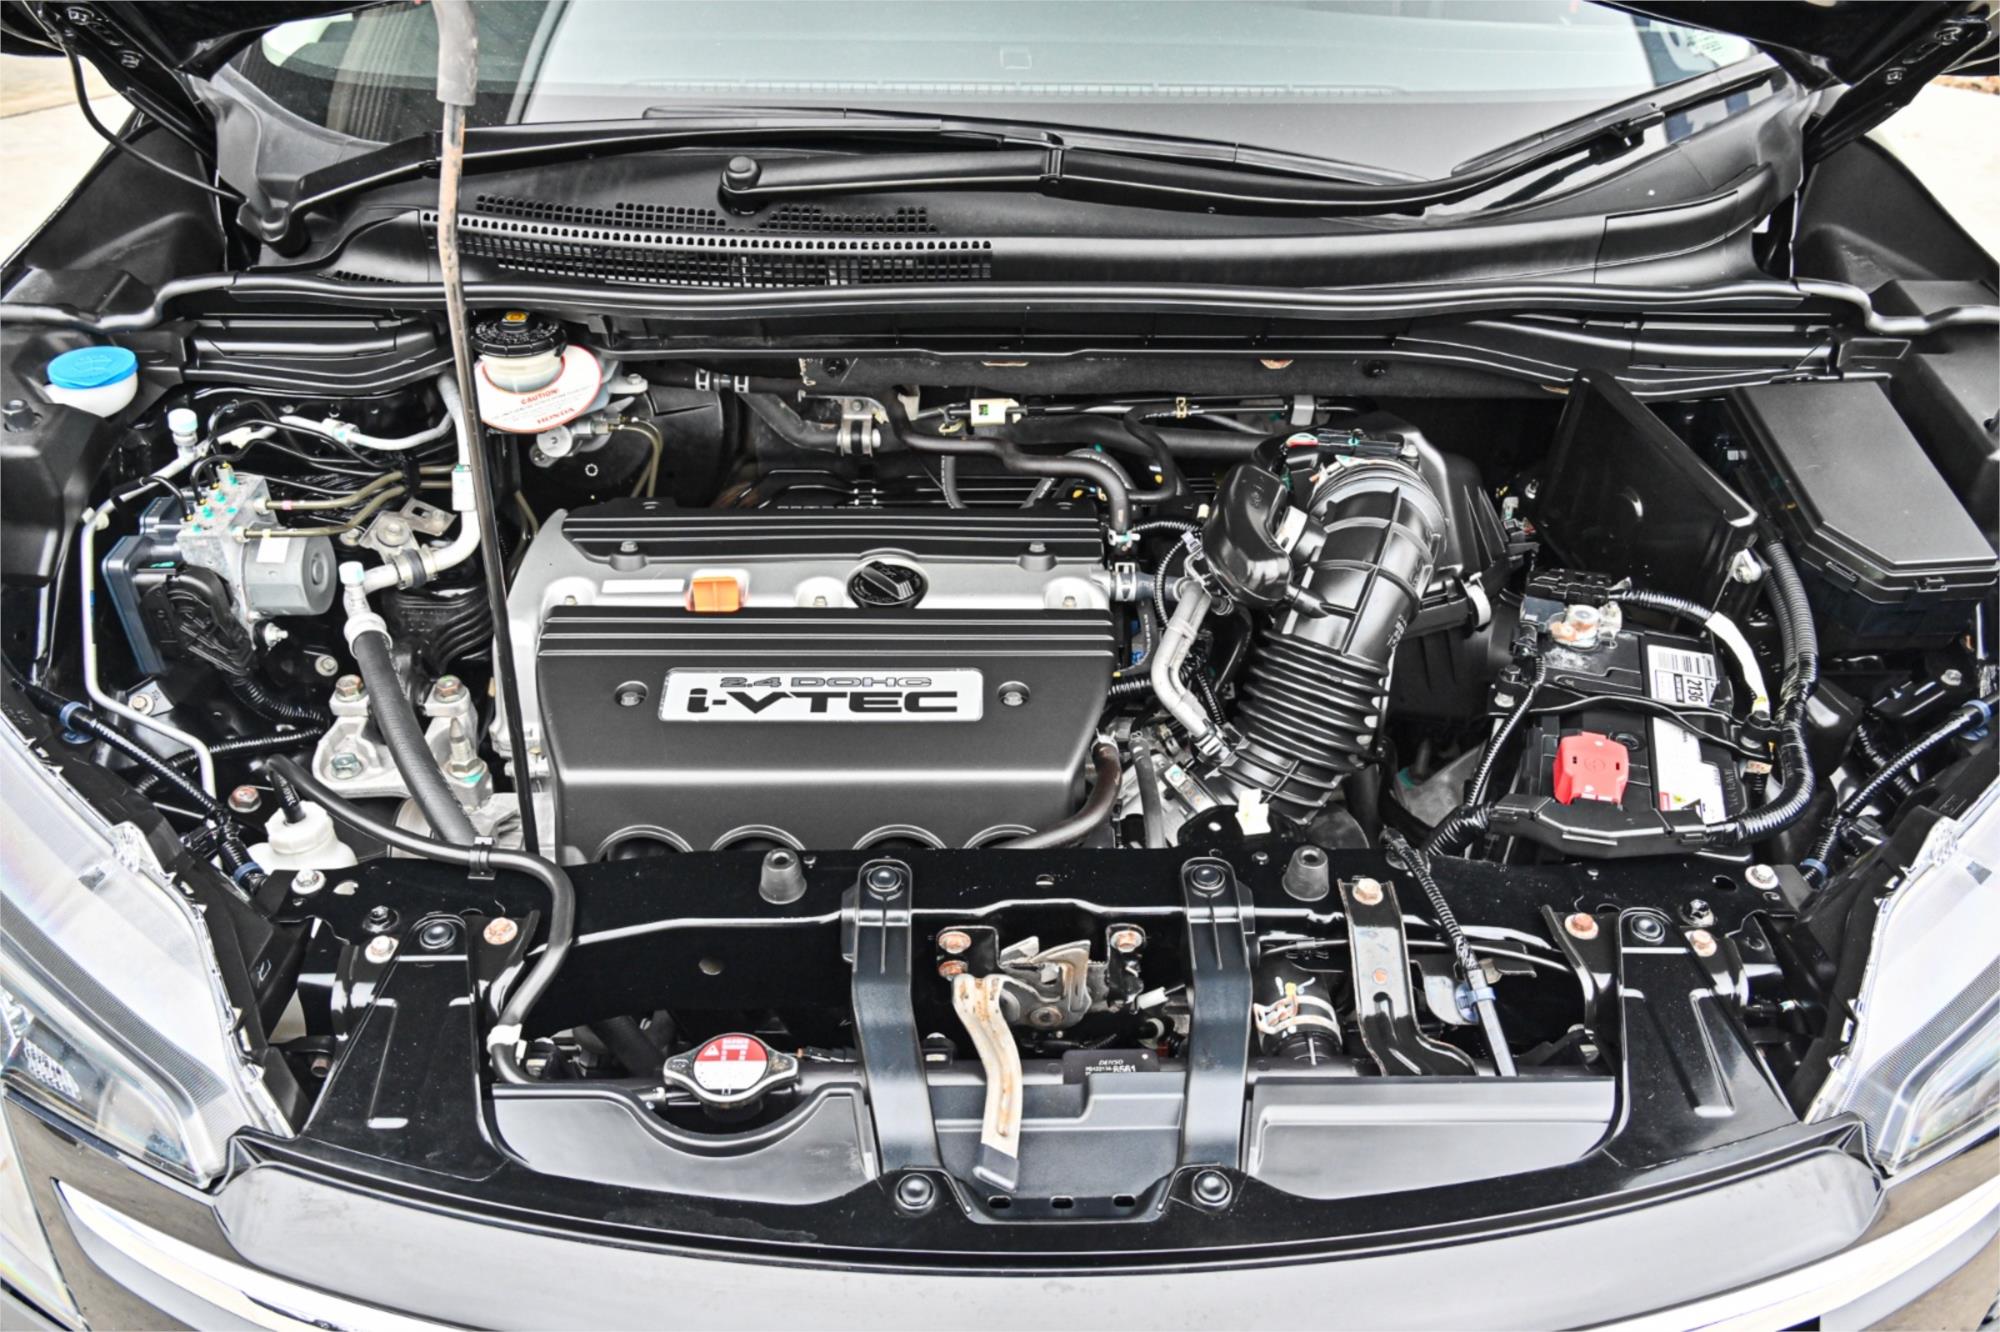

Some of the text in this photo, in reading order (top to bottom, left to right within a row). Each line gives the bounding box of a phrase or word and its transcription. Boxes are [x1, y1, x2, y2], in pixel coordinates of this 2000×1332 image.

[720, 676, 932, 688] 2.4 DOHC
[687, 687, 958, 714] i-VTEC
